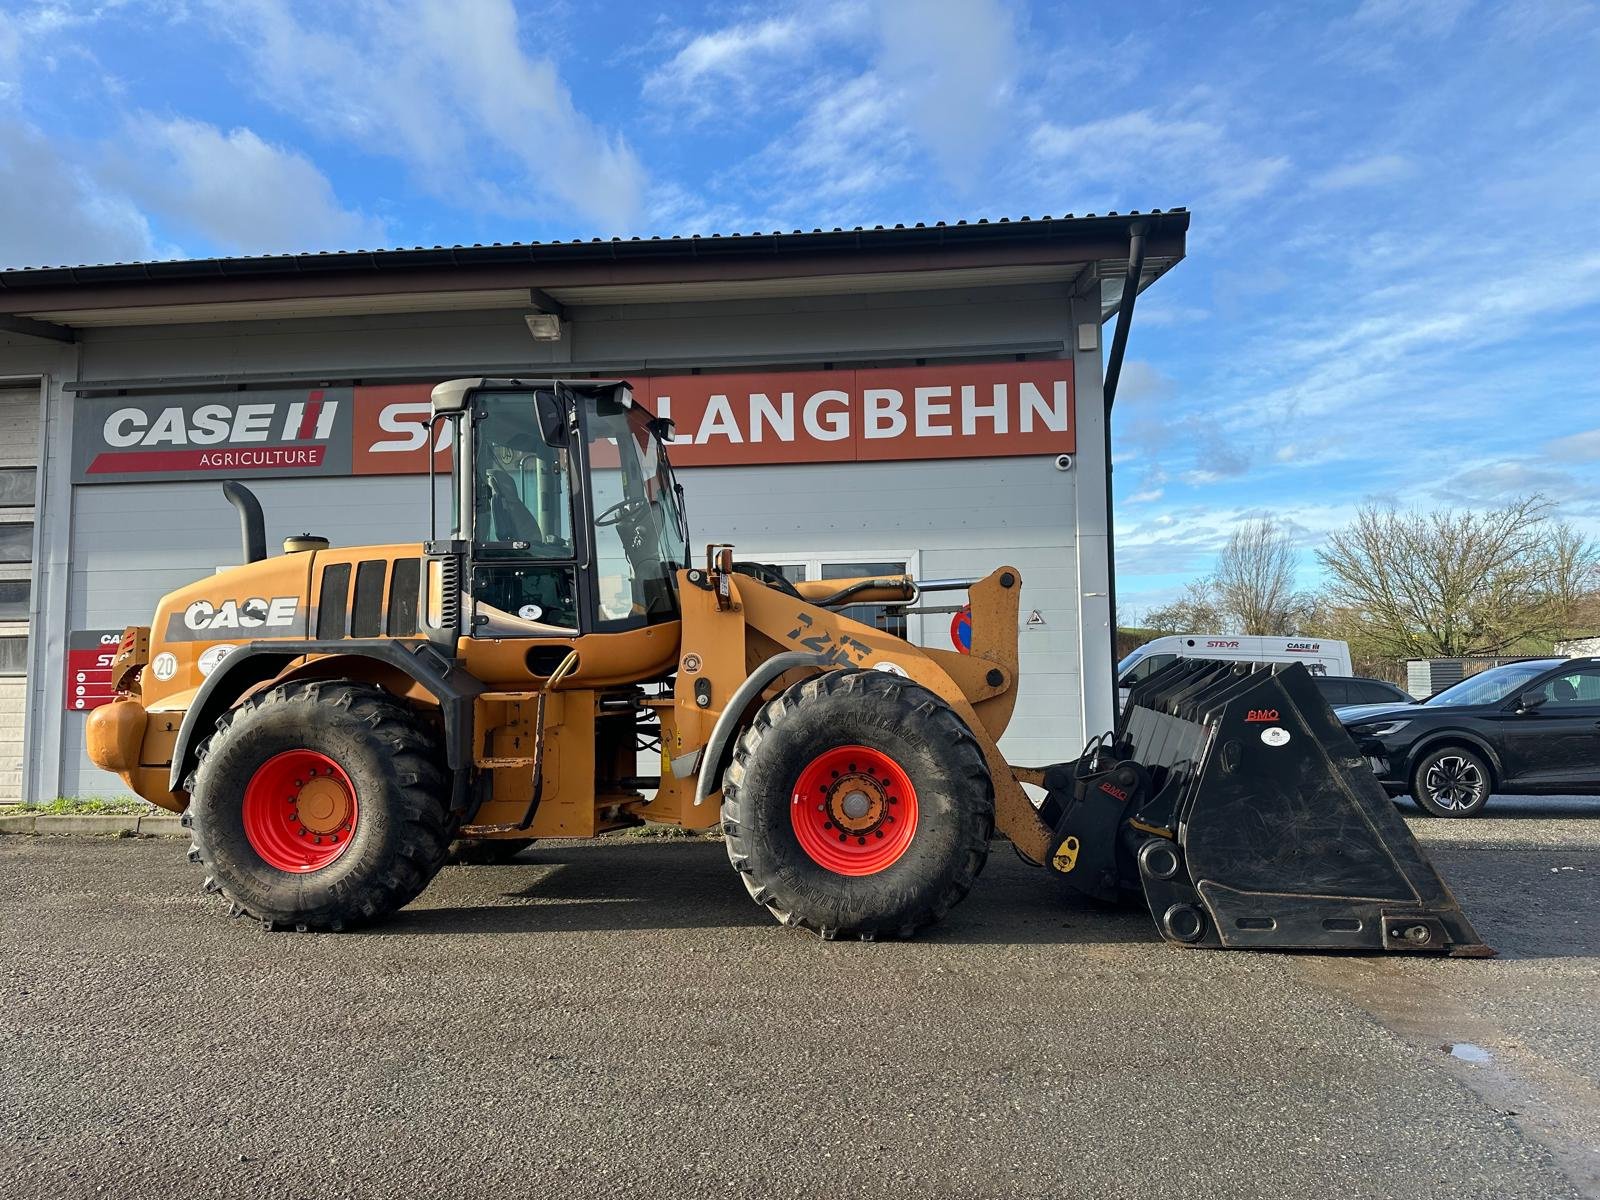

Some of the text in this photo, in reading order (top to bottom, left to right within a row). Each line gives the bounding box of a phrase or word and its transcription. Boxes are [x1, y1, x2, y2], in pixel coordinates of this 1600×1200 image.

[657, 380, 1068, 445] LANGBEHN
[103, 404, 275, 447] CASE
[200, 450, 317, 466] AGRICULTURE
[1206, 640, 1240, 648] STEYR
[1286, 642, 1311, 650] CASE
[156, 657, 174, 676] 20
